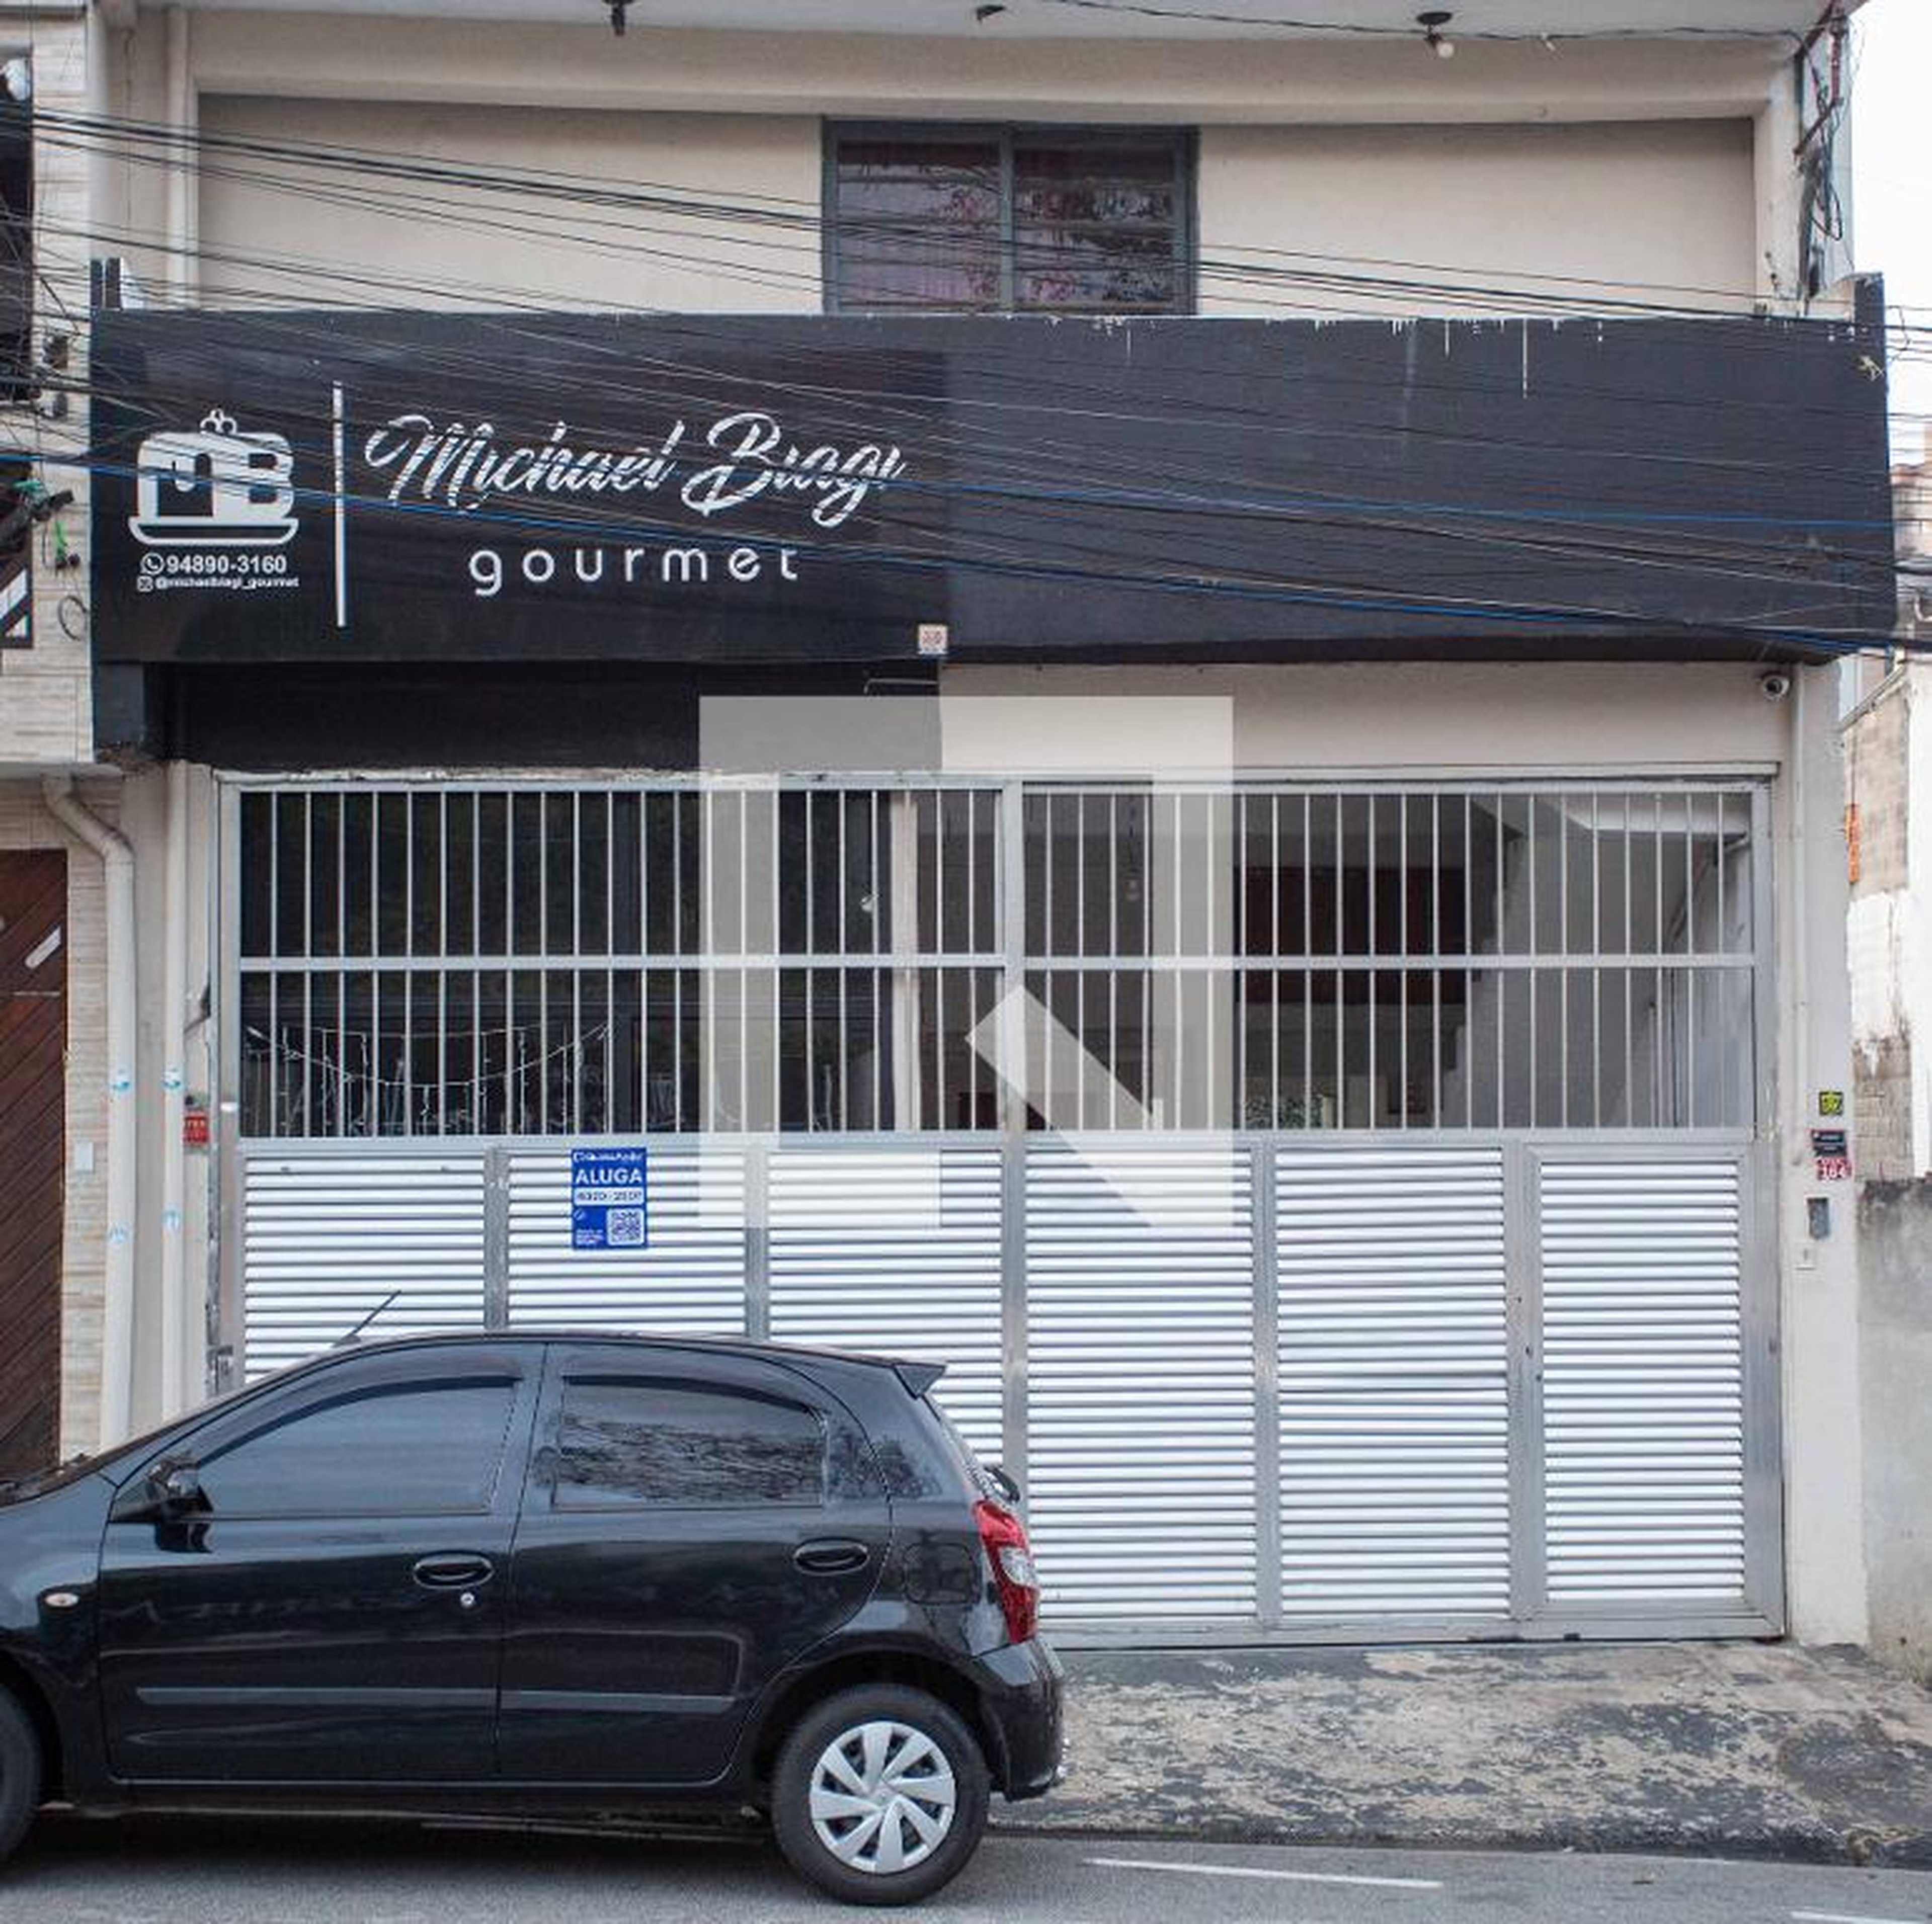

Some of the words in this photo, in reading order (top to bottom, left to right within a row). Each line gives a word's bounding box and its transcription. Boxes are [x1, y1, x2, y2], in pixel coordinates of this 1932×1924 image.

[167, 555, 287, 574] 94890-3160
[468, 547, 799, 597] gourmet
[576, 1167, 642, 1184] ALUGA
